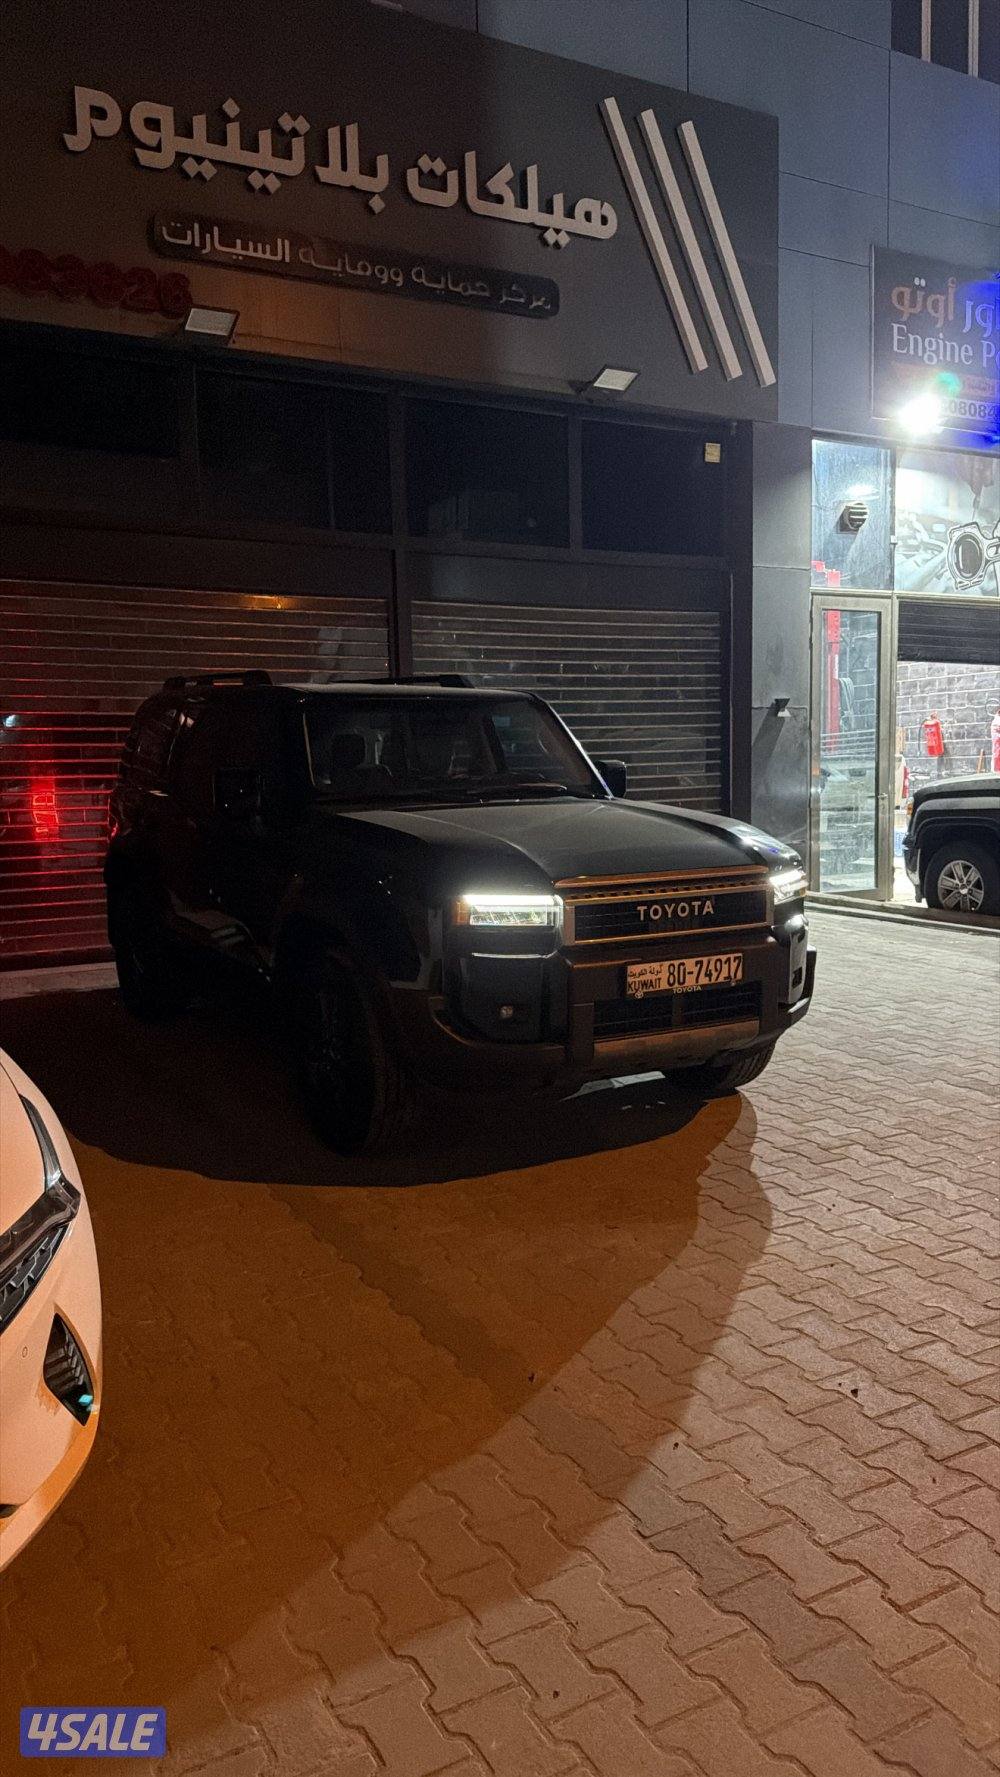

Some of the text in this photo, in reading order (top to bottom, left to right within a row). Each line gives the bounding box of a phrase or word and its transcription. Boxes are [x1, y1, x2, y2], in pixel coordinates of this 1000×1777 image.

[406, 150, 619, 248] هيلكات
[162, 221, 291, 264] السيارات
[890, 276, 957, 329] أوتو
[891, 322, 1000, 369] Engine P
[636, 900, 714, 921] TOYOTA
[627, 977, 662, 993] KUWAIT
[666, 955, 742, 987] 80-74917
[672, 985, 701, 994] TOYOTA
